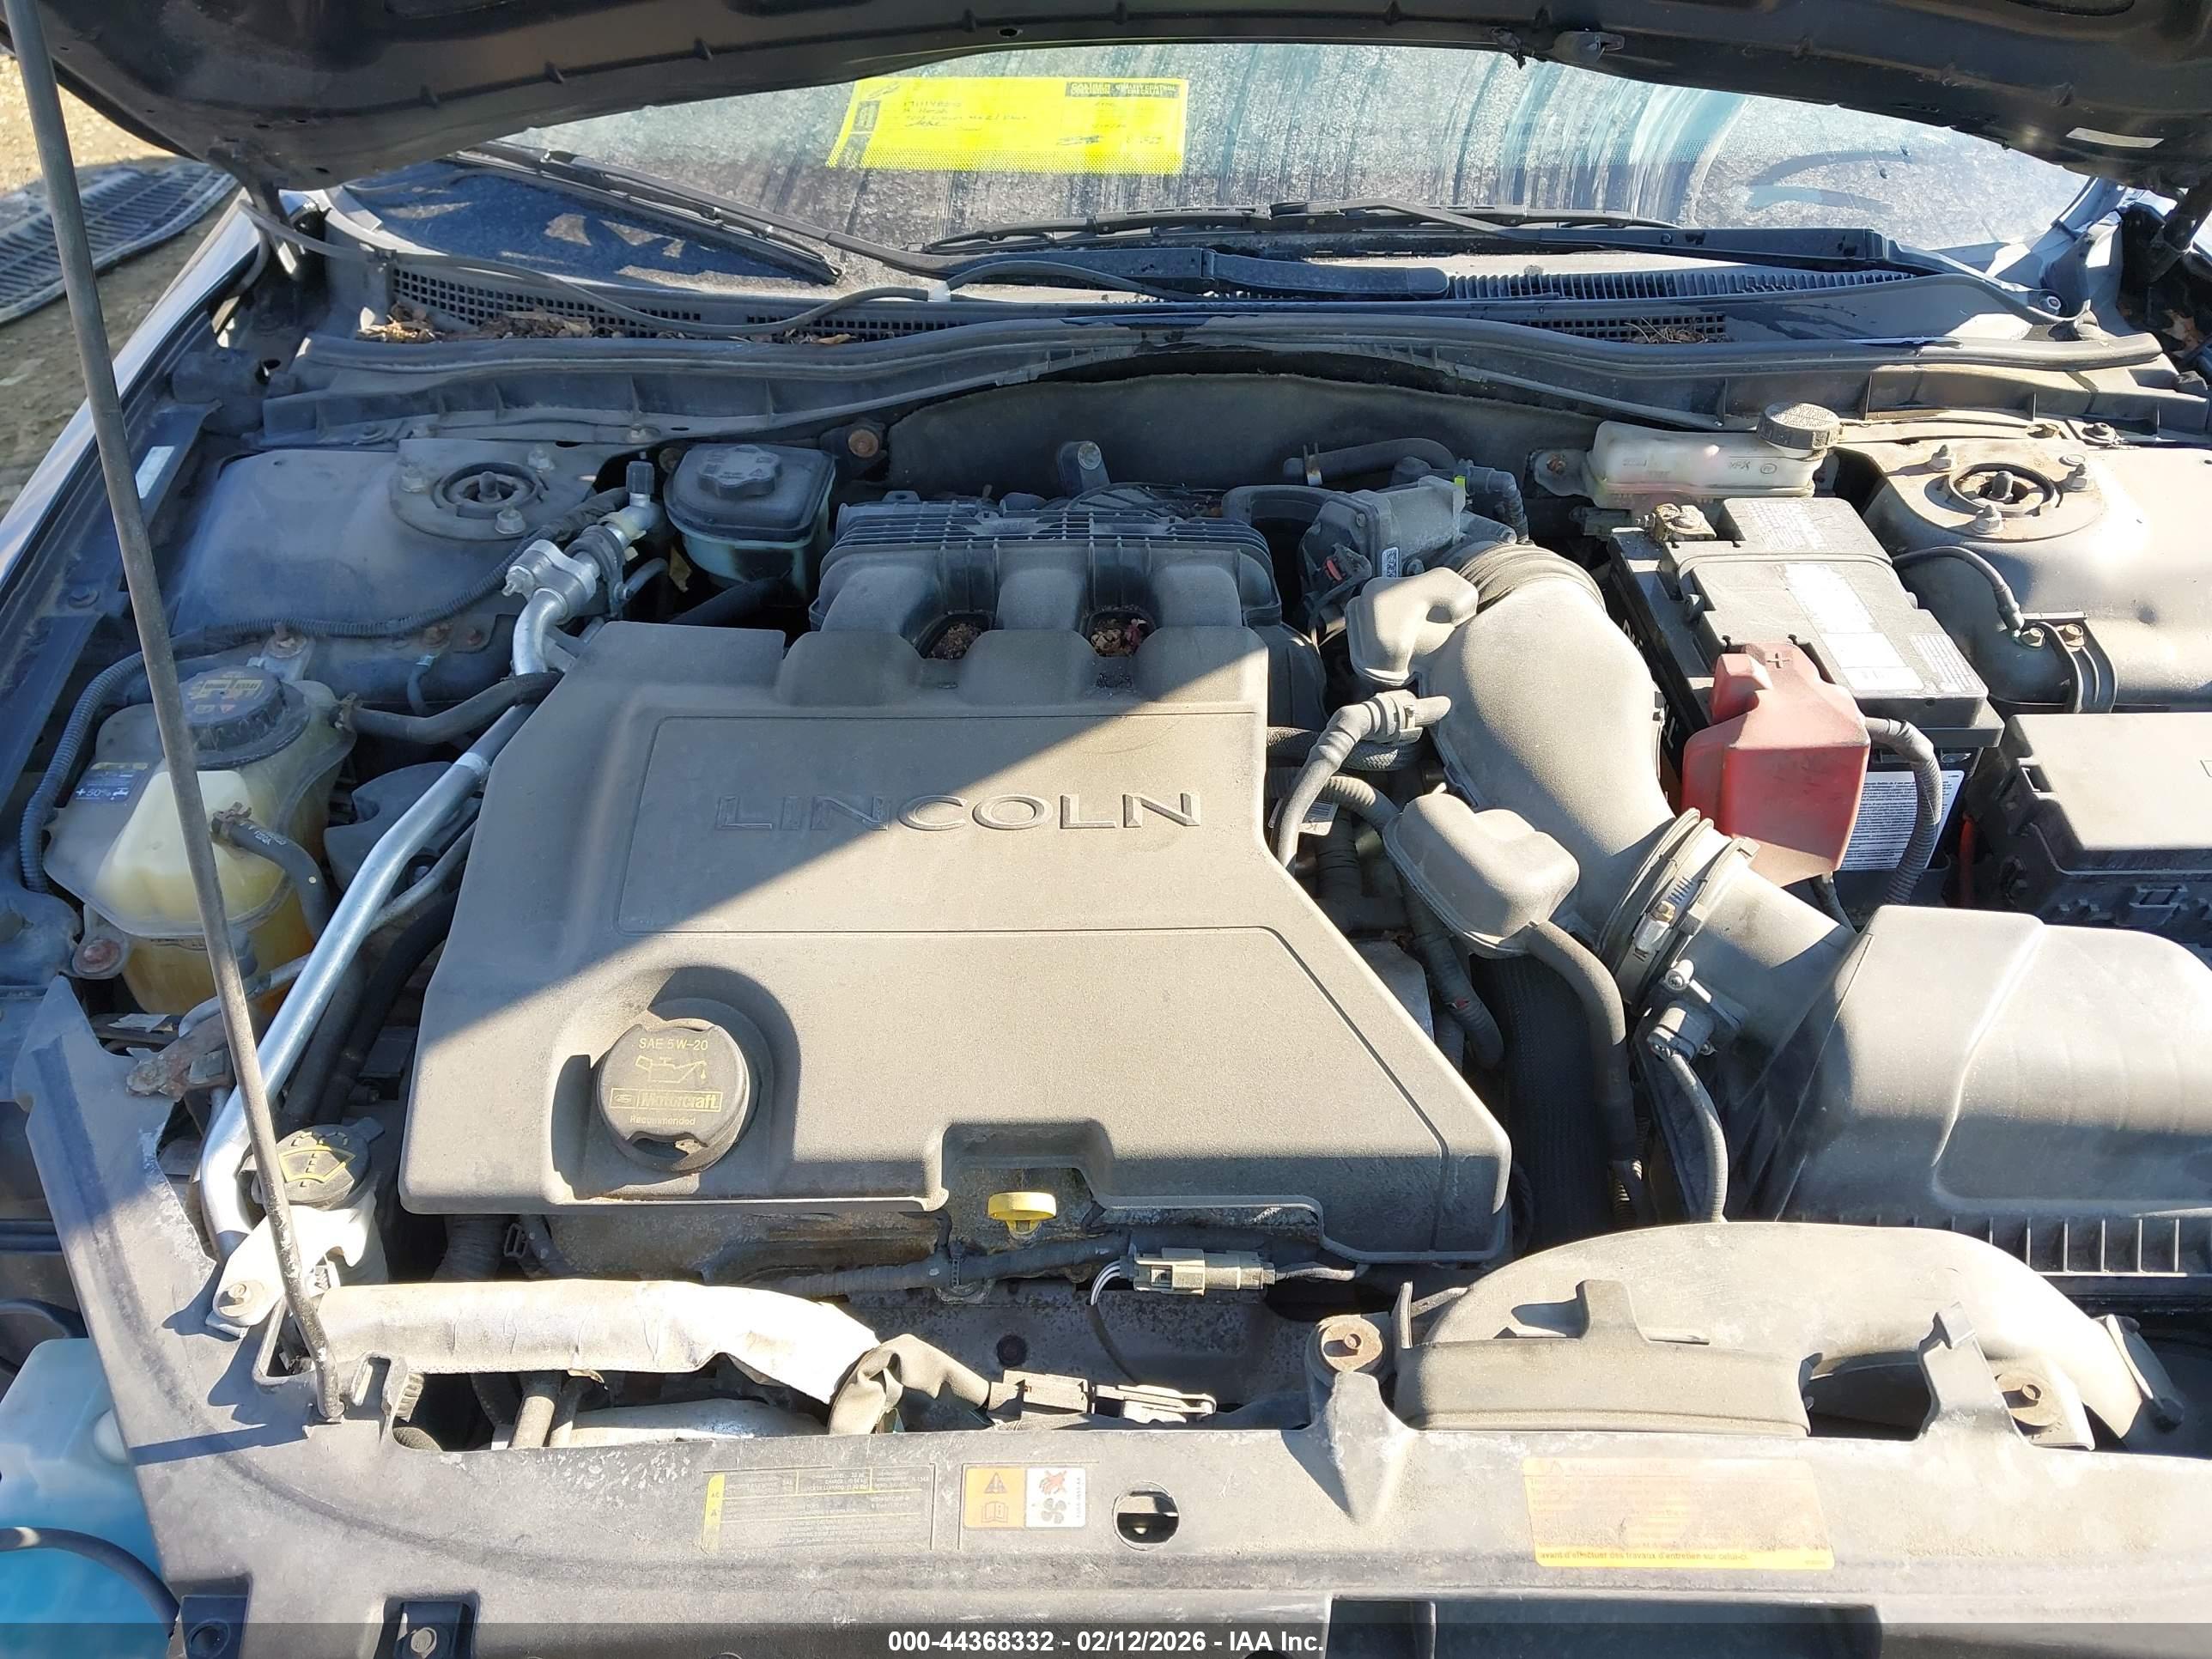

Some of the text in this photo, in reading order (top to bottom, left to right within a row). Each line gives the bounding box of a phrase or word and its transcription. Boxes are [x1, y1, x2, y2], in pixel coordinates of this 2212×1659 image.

[715, 792, 1202, 832] LINCOLN
[639, 1037, 708, 1051] SAE 5W-20
